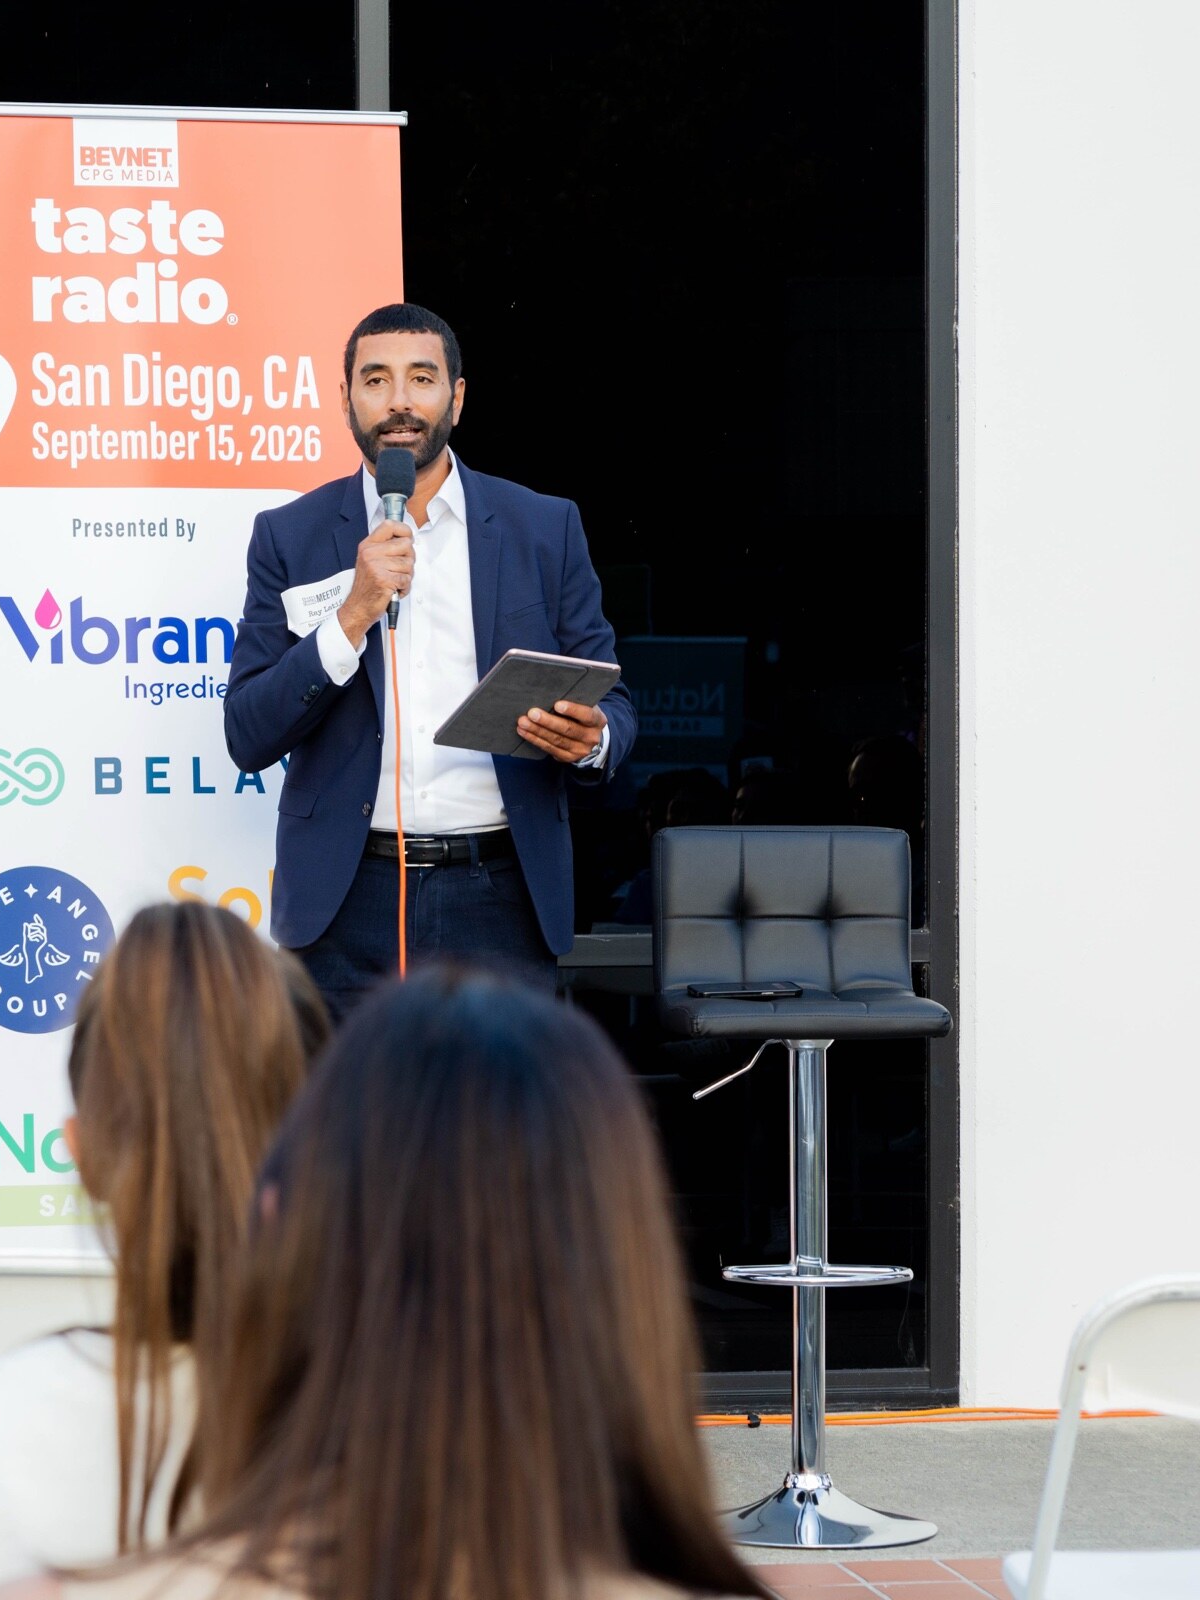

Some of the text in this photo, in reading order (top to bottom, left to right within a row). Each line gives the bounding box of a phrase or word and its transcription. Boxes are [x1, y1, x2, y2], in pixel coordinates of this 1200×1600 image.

[80, 146, 172, 167] BEVNET
[80, 169, 173, 182] CPG MEDIA
[31, 198, 225, 256] taste
[31, 351, 320, 421] San Diego, CA
[31, 421, 322, 469] September 15, 2026
[72, 517, 196, 542] Presented By
[315, 585, 342, 603] MEETUP
[94, 756, 291, 795] BELA
[167, 865, 275, 930] So
[46, 885, 100, 982] ANGEL
